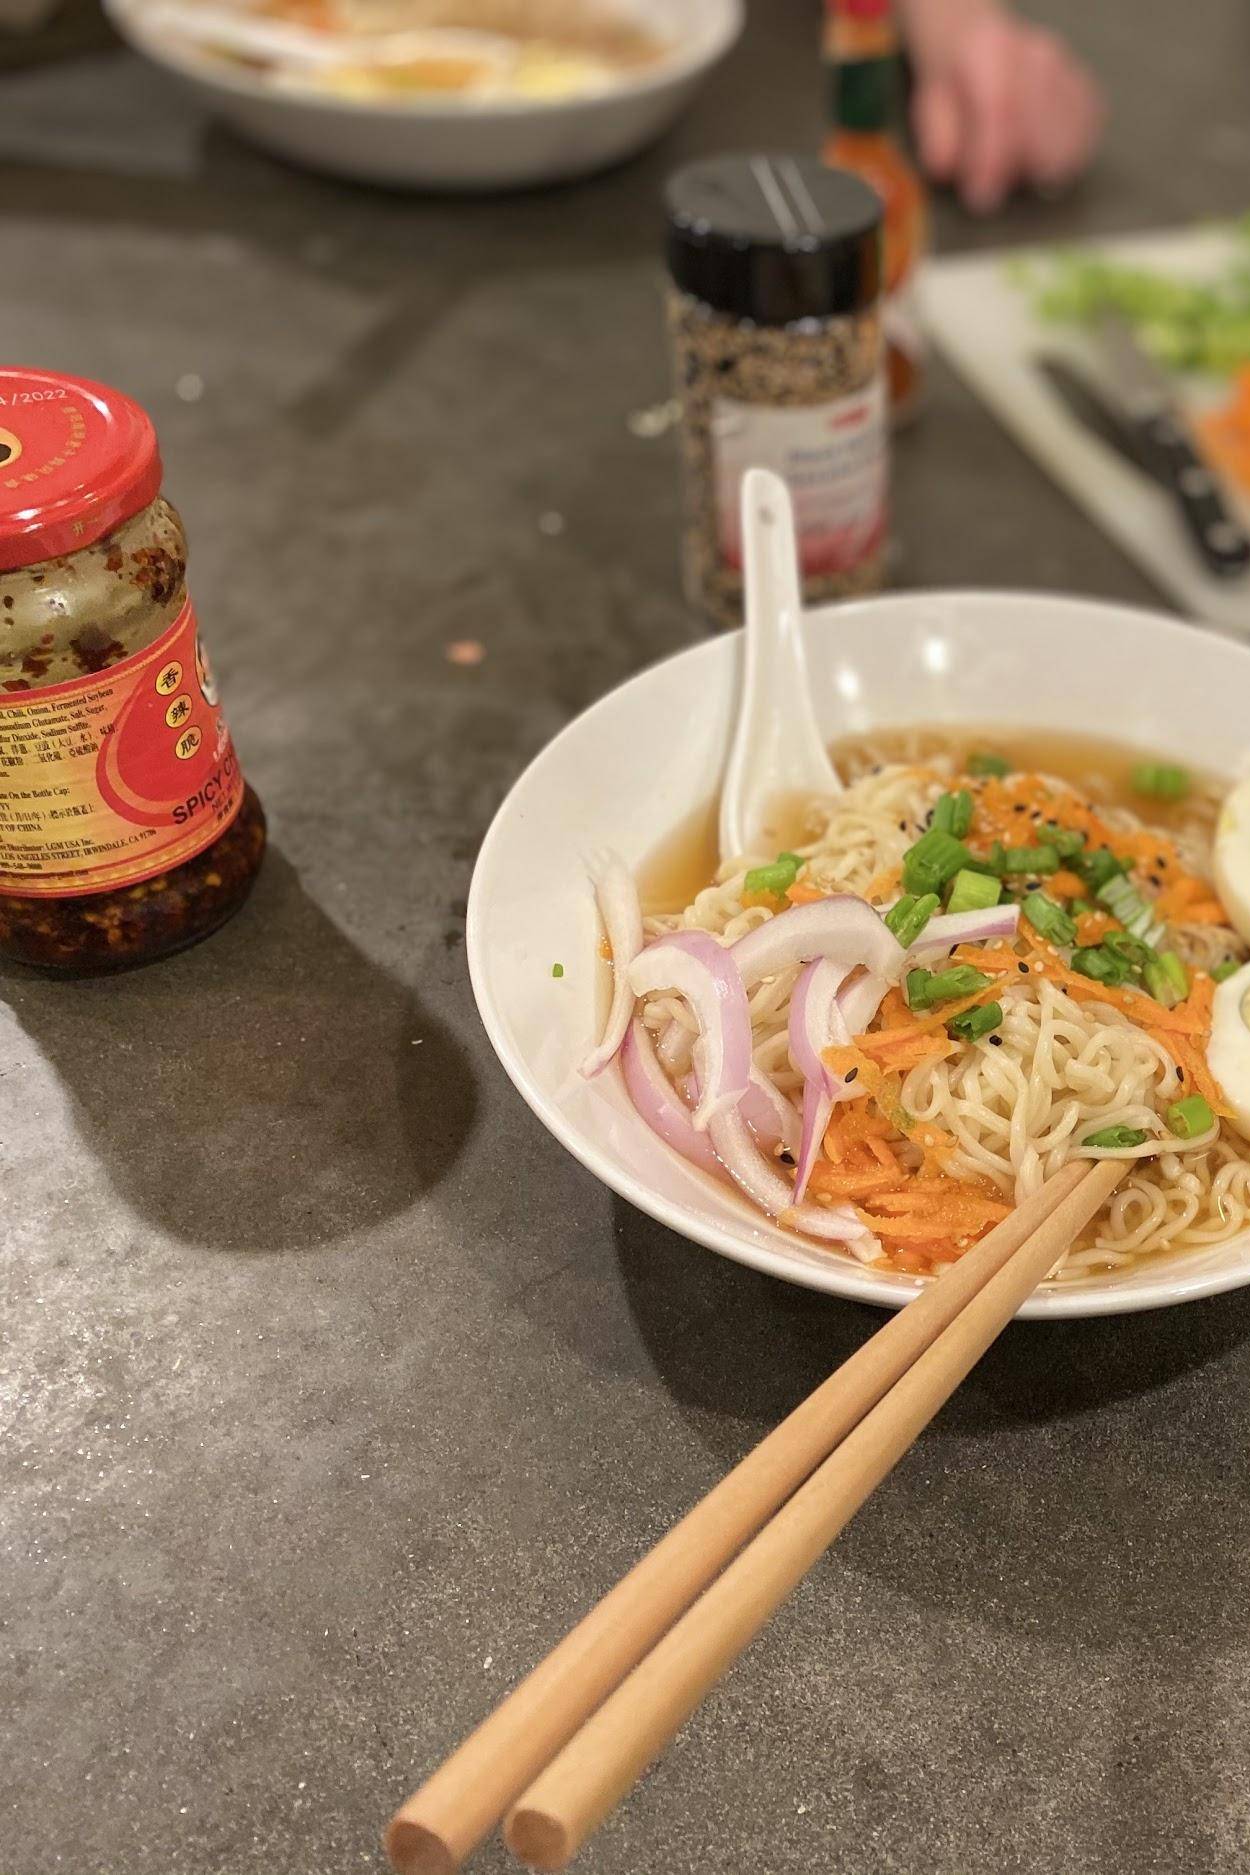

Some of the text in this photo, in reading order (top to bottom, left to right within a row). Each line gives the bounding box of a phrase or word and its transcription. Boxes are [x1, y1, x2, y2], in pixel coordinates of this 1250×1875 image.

[51, 698, 87, 712] Fermented
[87, 688, 114, 704] Soybean
[41, 727, 67, 738] Sodium
[9, 791, 20, 799] On
[21, 791, 31, 799] the
[32, 788, 53, 798] Bottle
[53, 786, 70, 796] Cap:
[172, 769, 222, 824] SPICY
[18, 824, 42, 832] CHINA
[16, 852, 51, 861] ANGELES
[128, 835, 140, 844] CA
[45, 841, 64, 851] LGM
[65, 840, 80, 849] USA
[80, 838, 95, 847] Inc.
